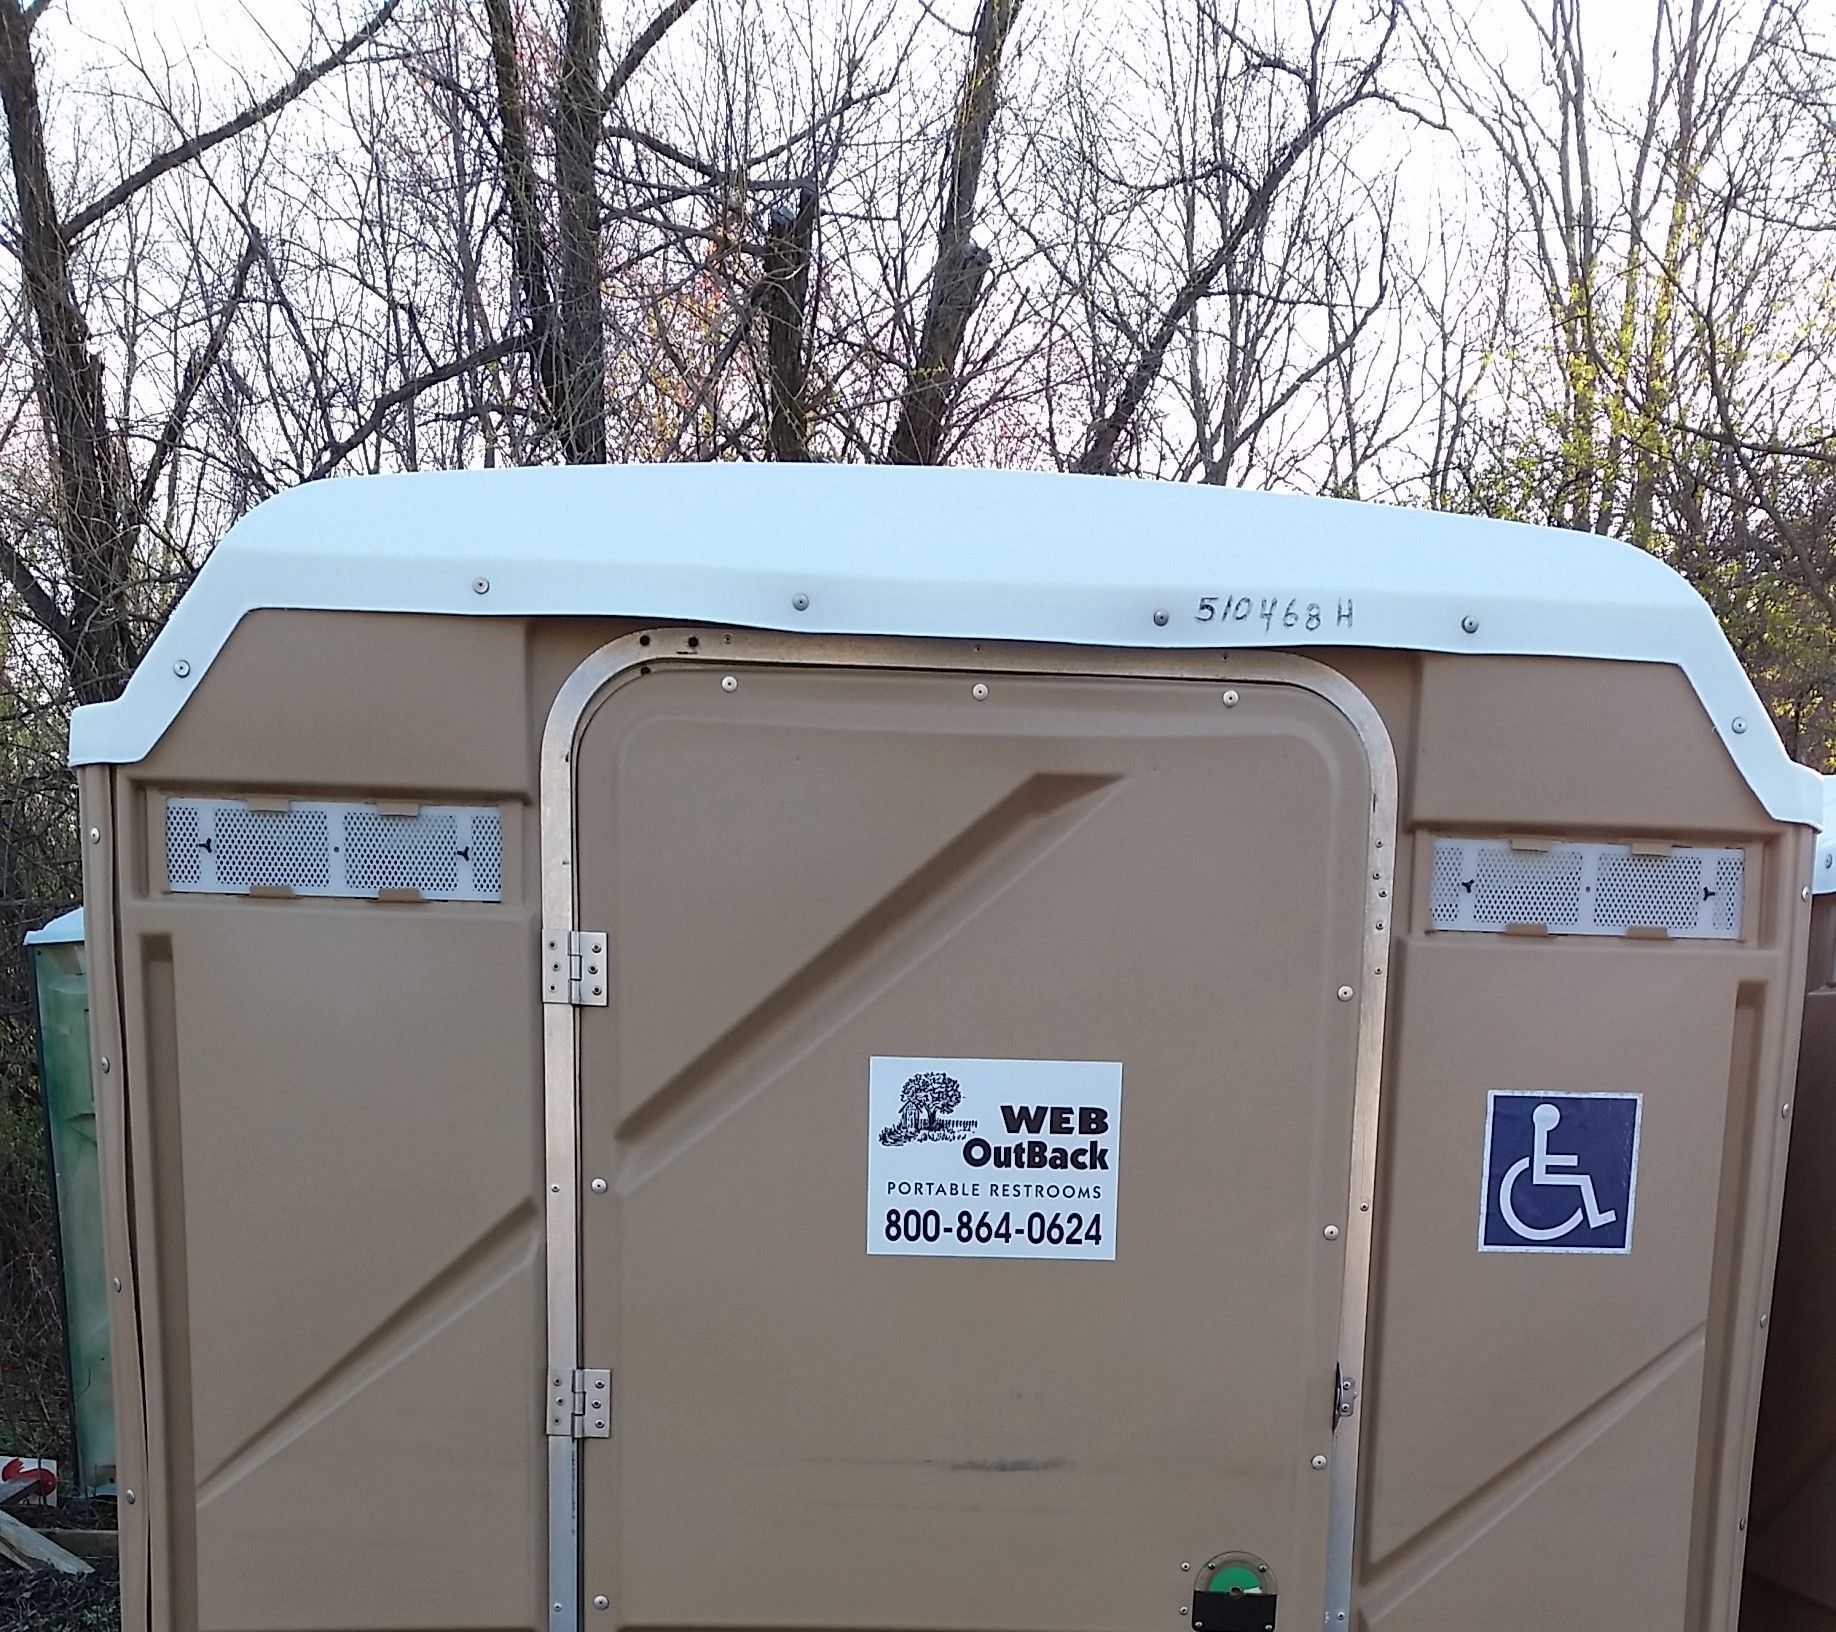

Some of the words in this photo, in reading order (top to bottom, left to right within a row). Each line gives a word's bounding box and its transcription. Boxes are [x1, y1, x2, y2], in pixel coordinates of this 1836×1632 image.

[1000, 1105, 1109, 1135] WEB
[962, 1137, 1109, 1170] OutBack
[887, 1181, 980, 1197] PORTABLE
[990, 1183, 1101, 1199] RESTROOMS
[885, 1208, 1102, 1246] 800-864-0624
